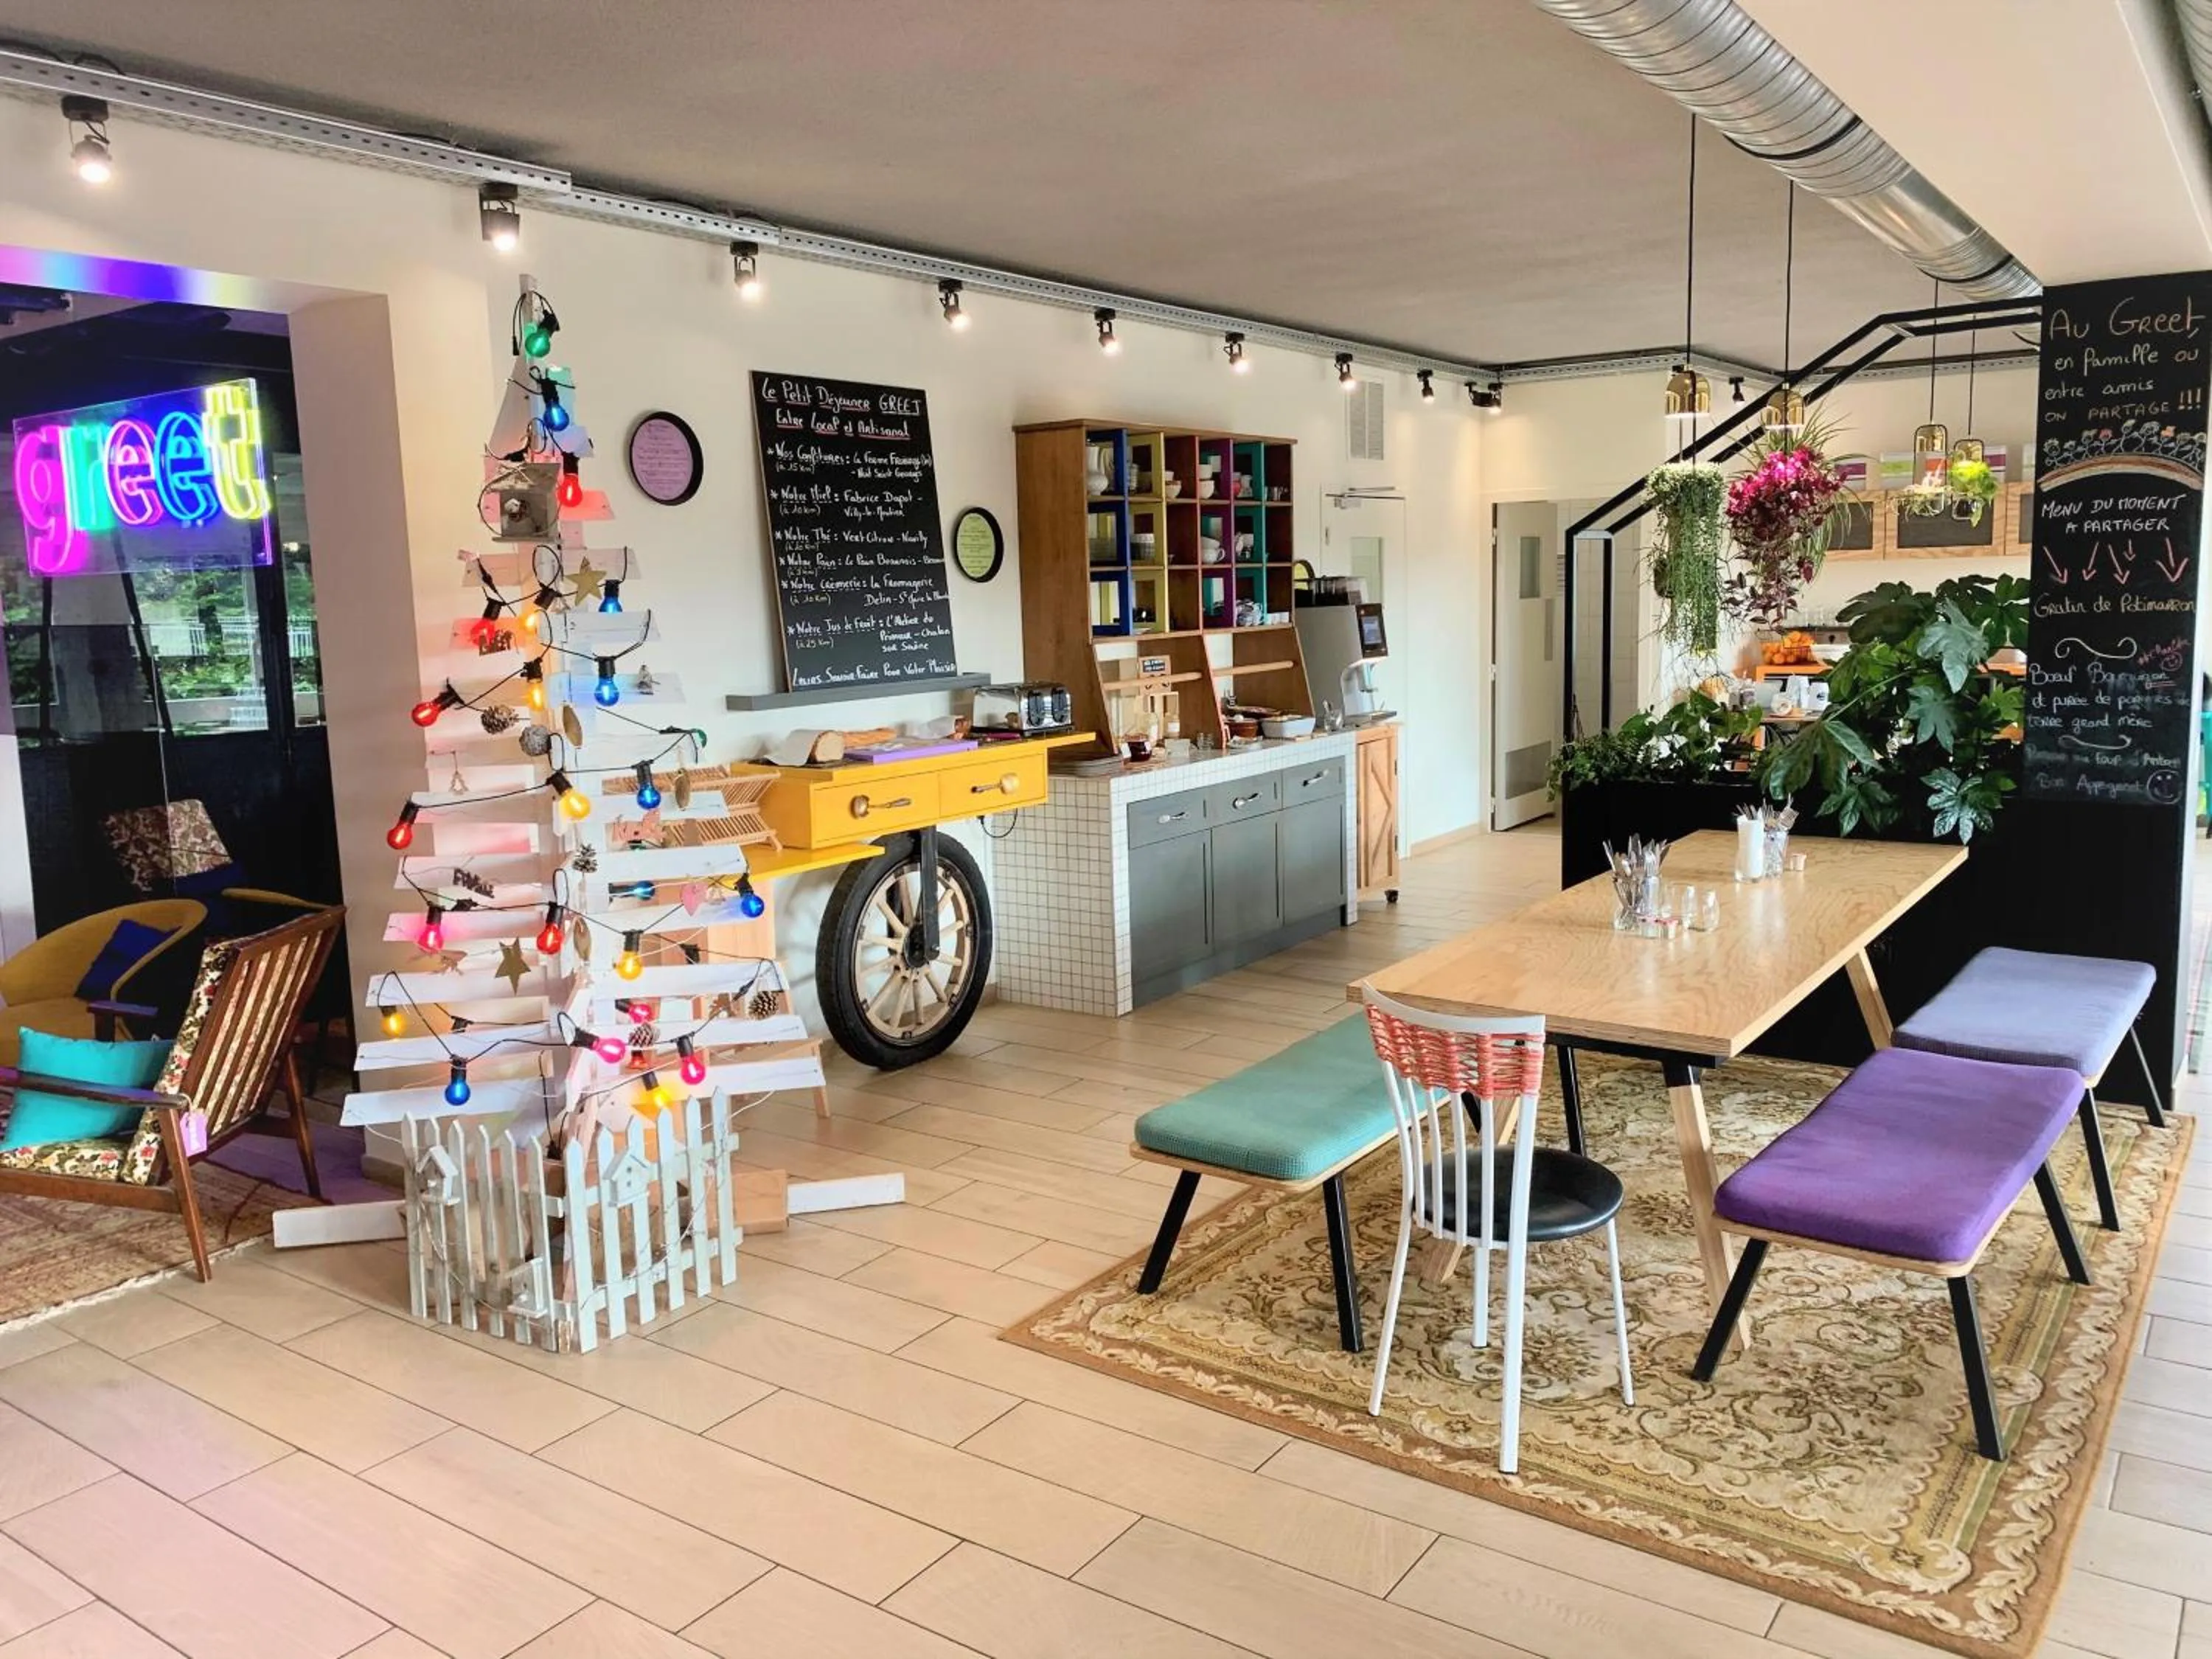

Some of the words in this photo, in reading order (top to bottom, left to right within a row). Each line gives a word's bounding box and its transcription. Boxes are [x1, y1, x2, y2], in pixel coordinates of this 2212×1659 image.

[2055, 356, 2073, 371] en
[2084, 343, 2159, 376] famille
[2174, 349, 2199, 362] ou
[762, 378, 776, 399] Le
[782, 380, 812, 403] Petit
[879, 394, 922, 415] GREET
[2045, 381, 2084, 400] entre
[2102, 380, 2154, 394] amis
[776, 408, 804, 425] Entre
[811, 412, 840, 431] Local
[2087, 402, 2170, 420] PARTAGE
[776, 441, 794, 459] Nos
[15, 385, 273, 572] greet
[781, 485, 807, 500] Notre
[844, 489, 879, 503] Fabrice
[2091, 498, 2112, 513] DU
[2118, 494, 2187, 510] MOMENT
[785, 526, 809, 540] Notre
[2084, 518, 2170, 533] PARTAGER
[787, 554, 810, 566] Notre
[790, 577, 815, 589] Notre
[2093, 594, 2112, 613] de
[797, 622, 821, 634] Notre
[824, 619, 841, 631] Jus
[2095, 689, 2111, 705] de
[2071, 714, 2110, 734] grand
